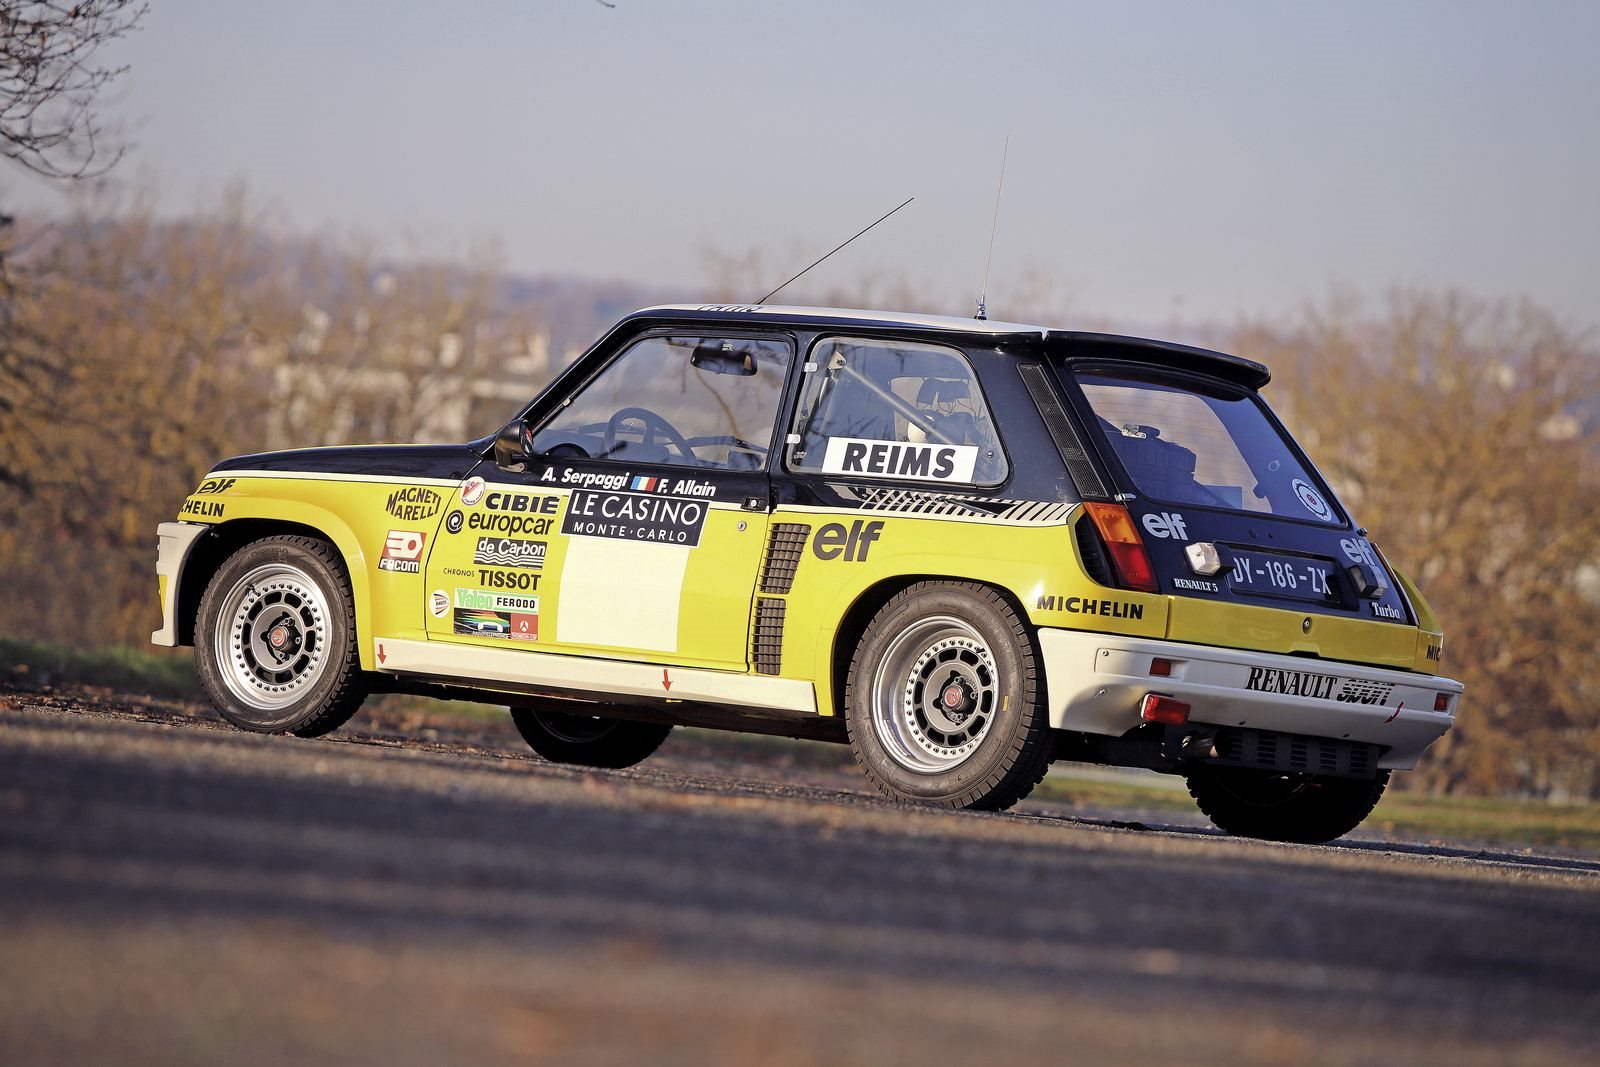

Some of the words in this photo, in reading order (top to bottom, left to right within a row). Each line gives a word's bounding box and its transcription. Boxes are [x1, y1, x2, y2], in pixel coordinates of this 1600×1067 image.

[841, 442, 956, 479] REIMS
[197, 479, 237, 494] elf
[541, 467, 556, 482] A.
[561, 468, 630, 490] Serpaggi
[657, 479, 668, 494] F.
[672, 480, 717, 497] Allain
[181, 500, 225, 517] HELIN
[386, 487, 442, 508] MAGNETI
[386, 498, 442, 521] MARELLI
[570, 492, 599, 516] LE
[601, 495, 701, 526] CASINO
[468, 512, 555, 537] europcar
[1141, 511, 1188, 541] elf
[478, 537, 495, 554] de
[498, 539, 546, 556] Carbon
[812, 520, 885, 562] elf
[1340, 538, 1376, 566] elf
[443, 567, 475, 577] CHRONOS
[478, 569, 542, 590] TISSOT
[1173, 577, 1211, 592] RENAULT
[1211, 582, 1219, 593] 5
[456, 588, 494, 609] Valeo
[496, 597, 536, 609] FERODO
[1036, 594, 1144, 620] MICHELIN
[1371, 601, 1400, 619] Turbo
[1244, 666, 1338, 700] RENAULT
